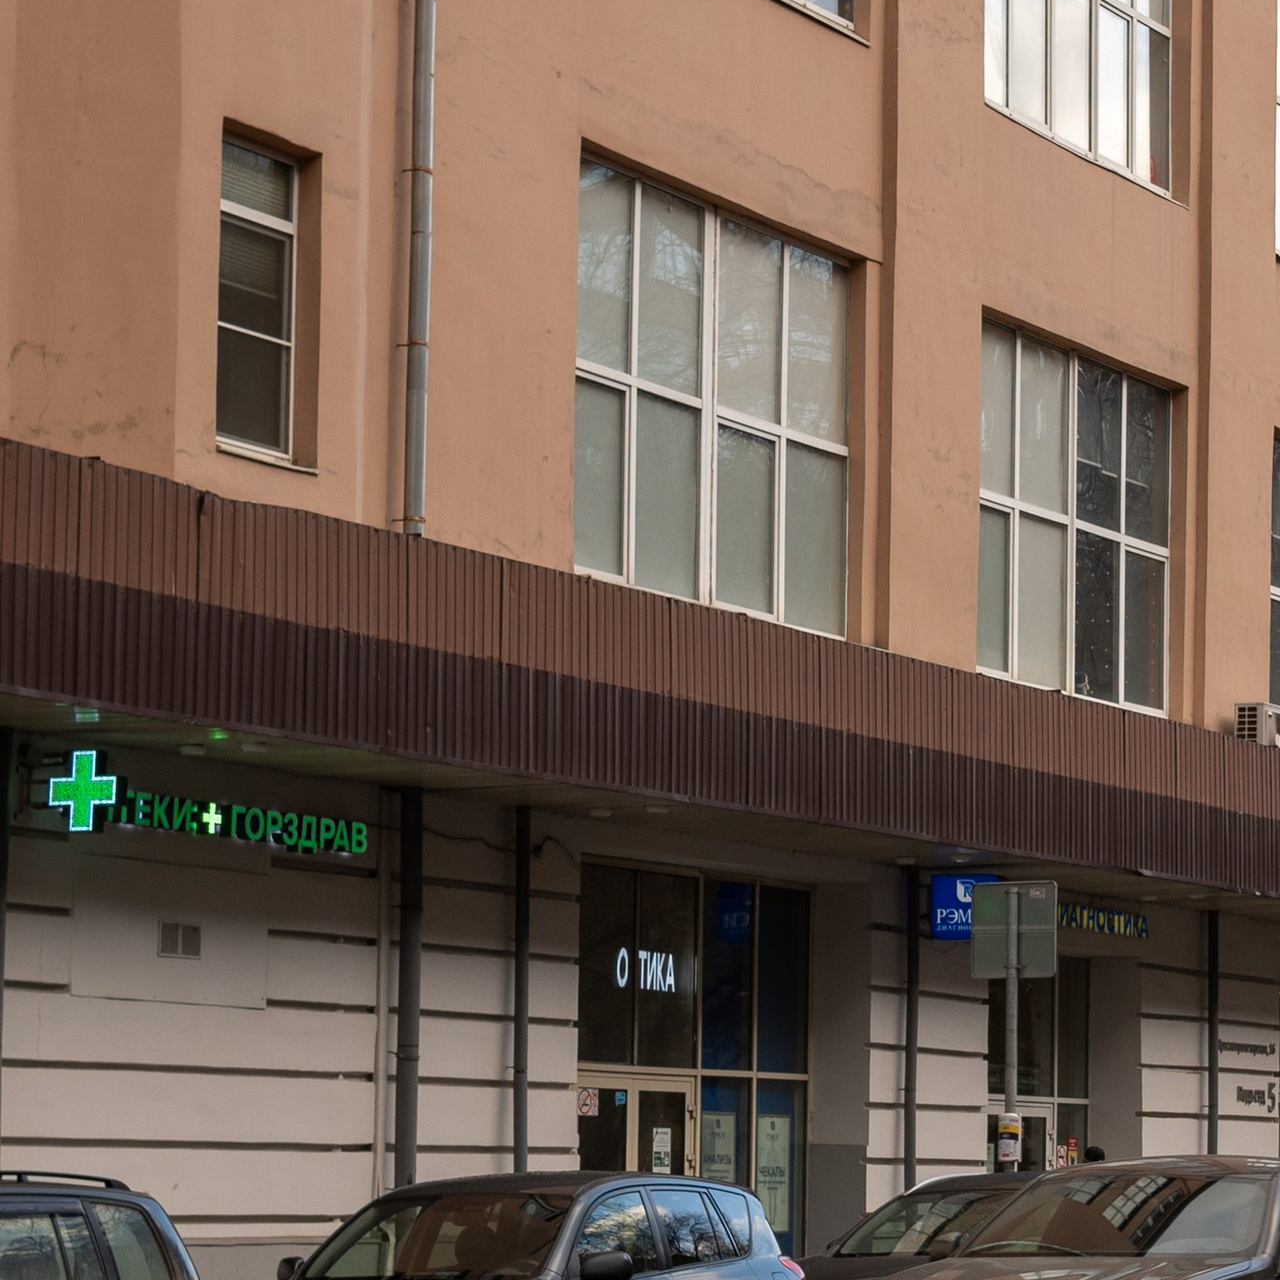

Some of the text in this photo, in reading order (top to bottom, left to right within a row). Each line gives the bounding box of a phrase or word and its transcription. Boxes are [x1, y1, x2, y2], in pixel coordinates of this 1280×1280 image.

[231, 804, 367, 854] ГОРЗДРАВ
[936, 908, 972, 924] РЭМ
[1057, 903, 1149, 939] ИАГНОСТИКА
[616, 947, 676, 993] ОТИКА
[1267, 1082, 1276, 1114] 5
